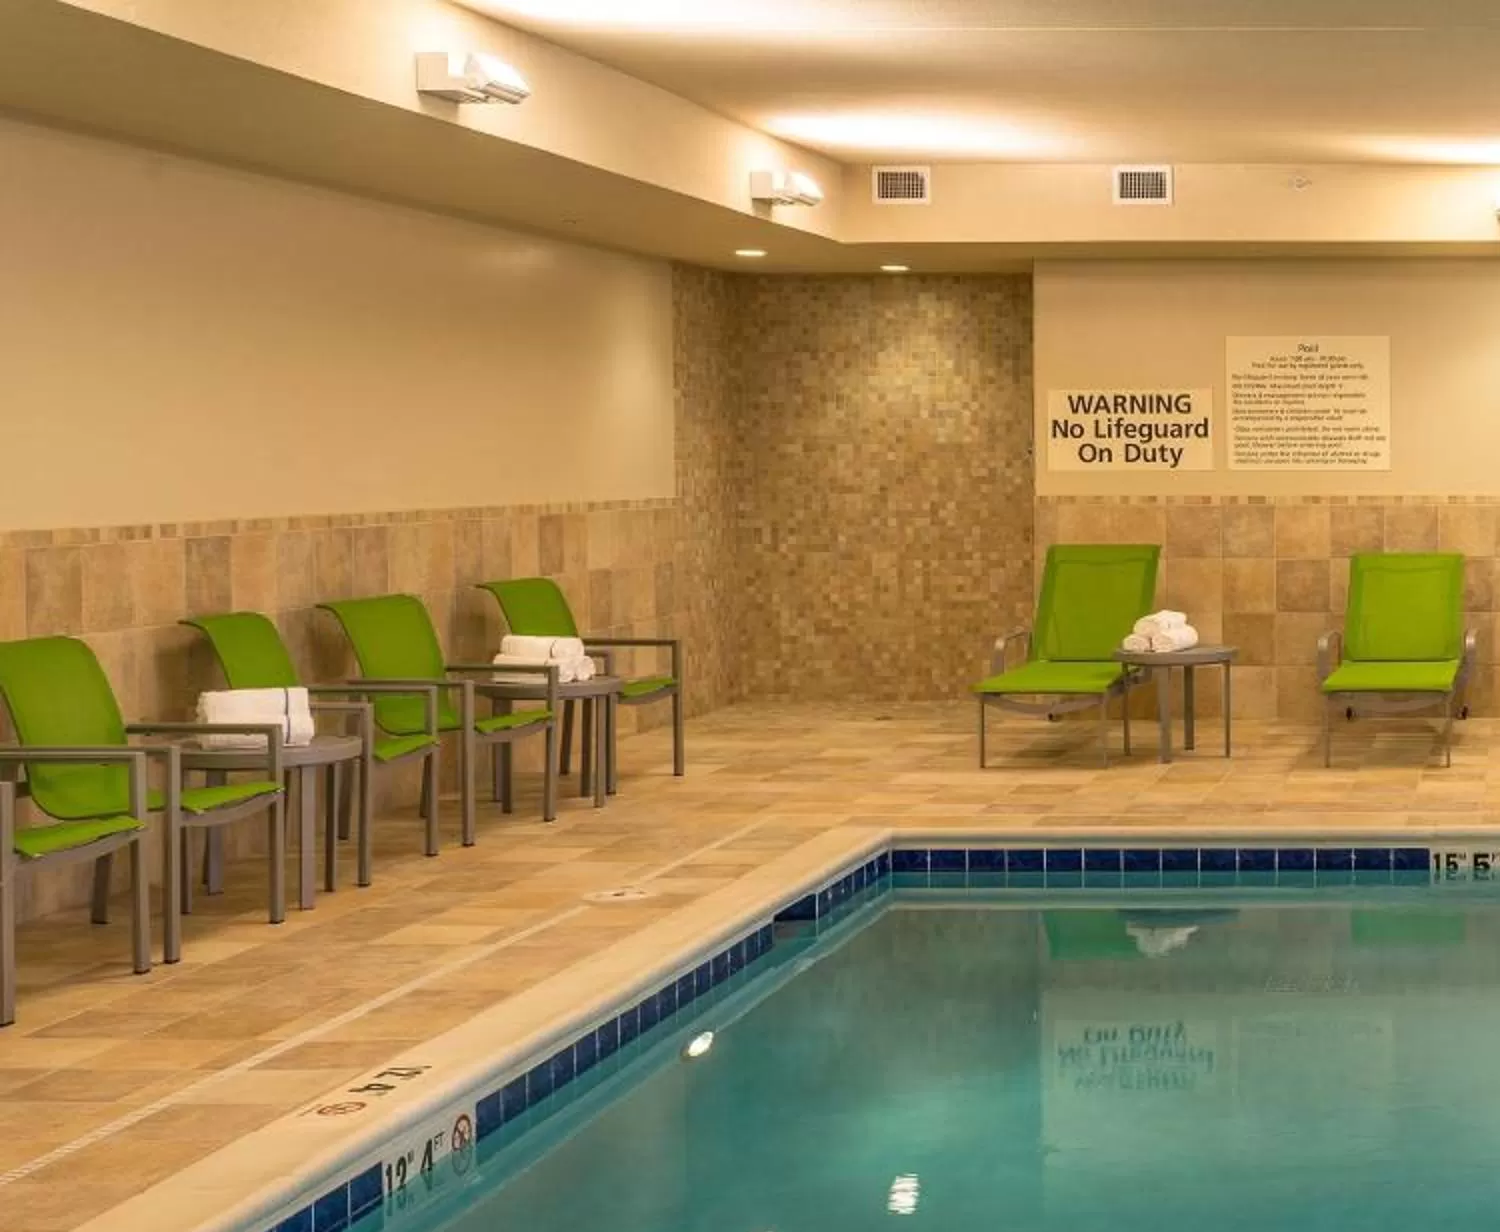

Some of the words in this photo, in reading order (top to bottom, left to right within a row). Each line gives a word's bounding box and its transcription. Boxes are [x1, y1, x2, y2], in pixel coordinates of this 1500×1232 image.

[1297, 343, 1320, 353] Pool
[1067, 394, 1192, 414] WARNING
[1051, 419, 1085, 439] No
[1094, 417, 1209, 443] Lifeguard
[1078, 443, 1113, 463] On
[1124, 443, 1184, 468] Duty
